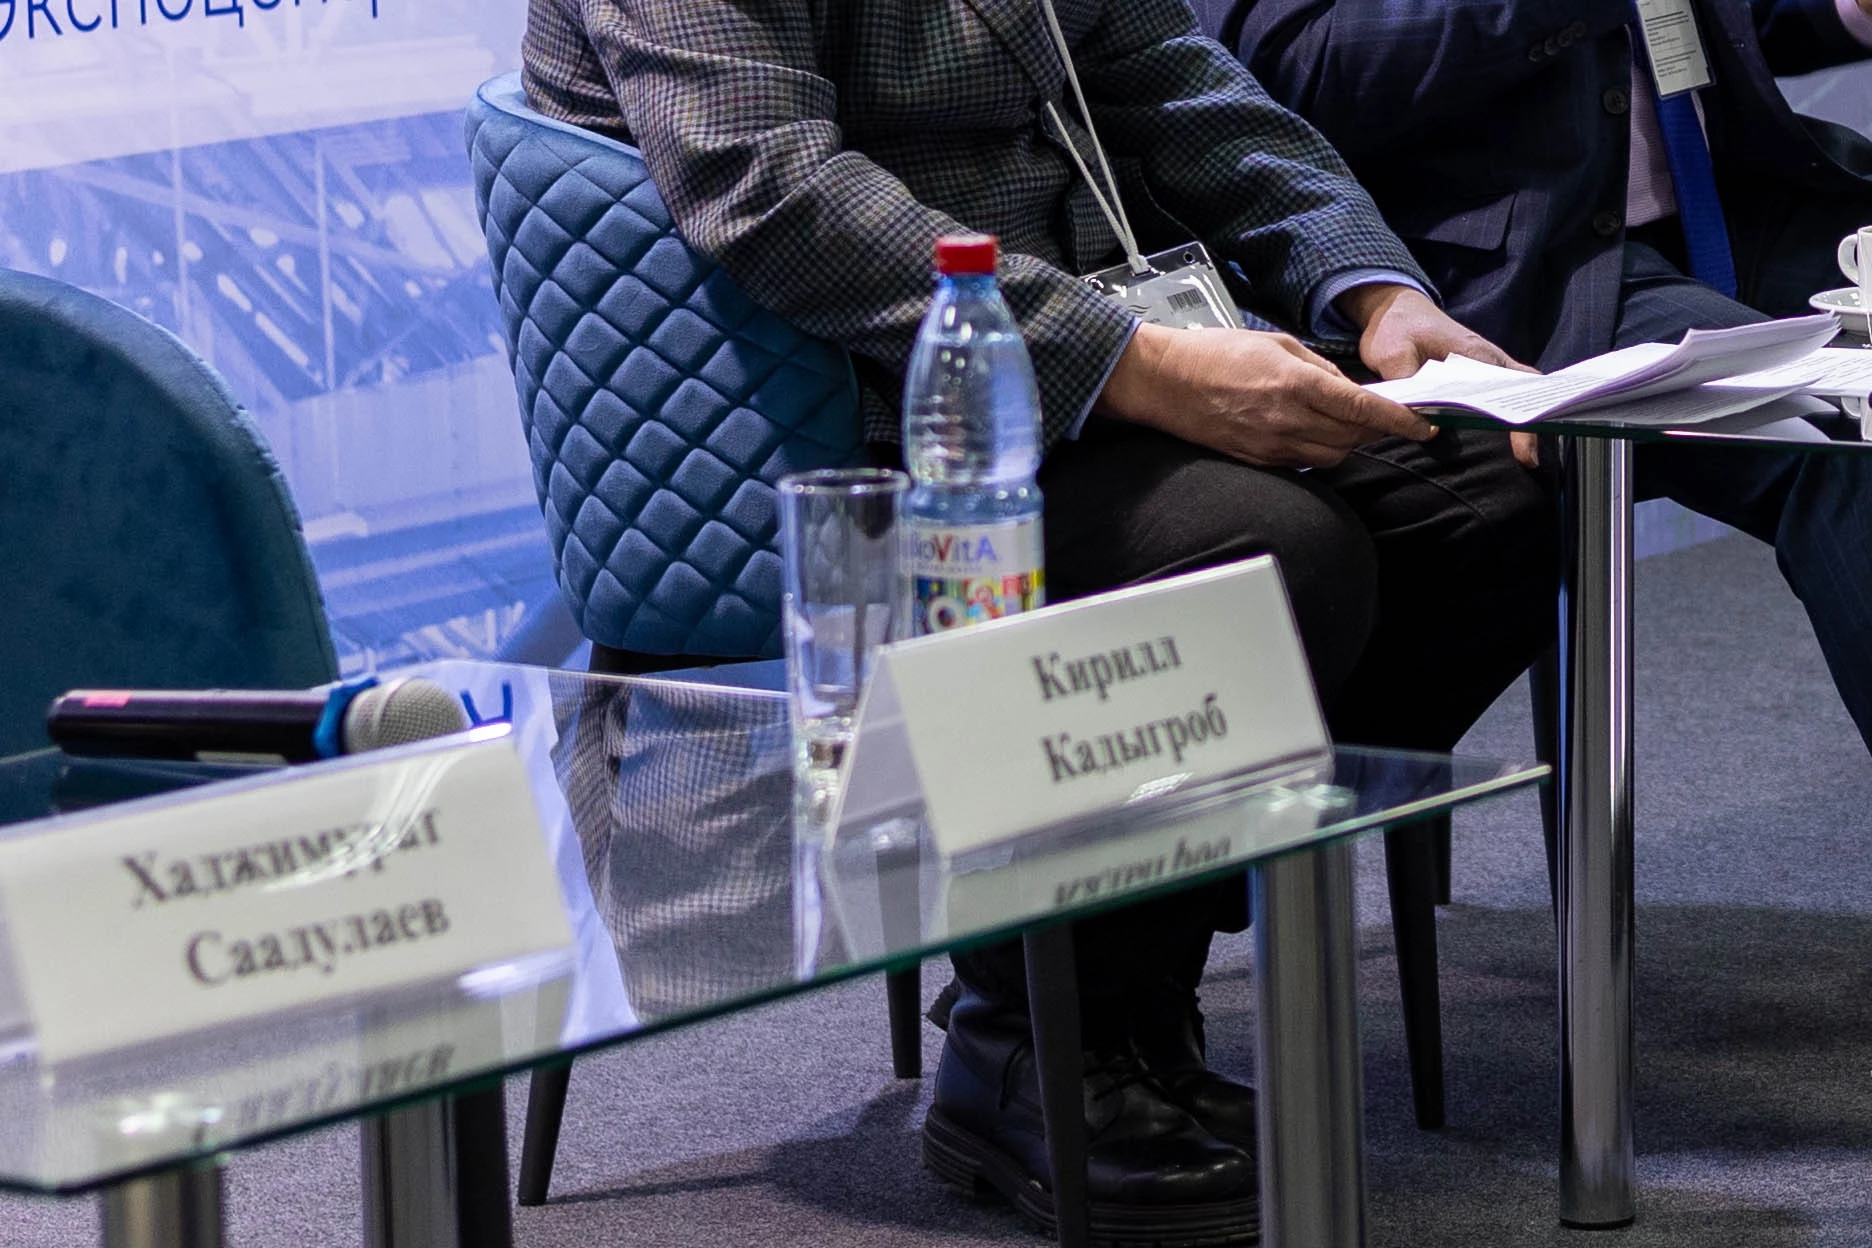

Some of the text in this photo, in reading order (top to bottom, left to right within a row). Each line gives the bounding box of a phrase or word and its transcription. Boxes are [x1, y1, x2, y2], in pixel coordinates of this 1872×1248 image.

[1031, 634, 1183, 703] Кирилл
[1041, 691, 1229, 783] Кадыгроб
[121, 807, 441, 911] Хаджимат
[183, 897, 453, 987] Саадулаев
